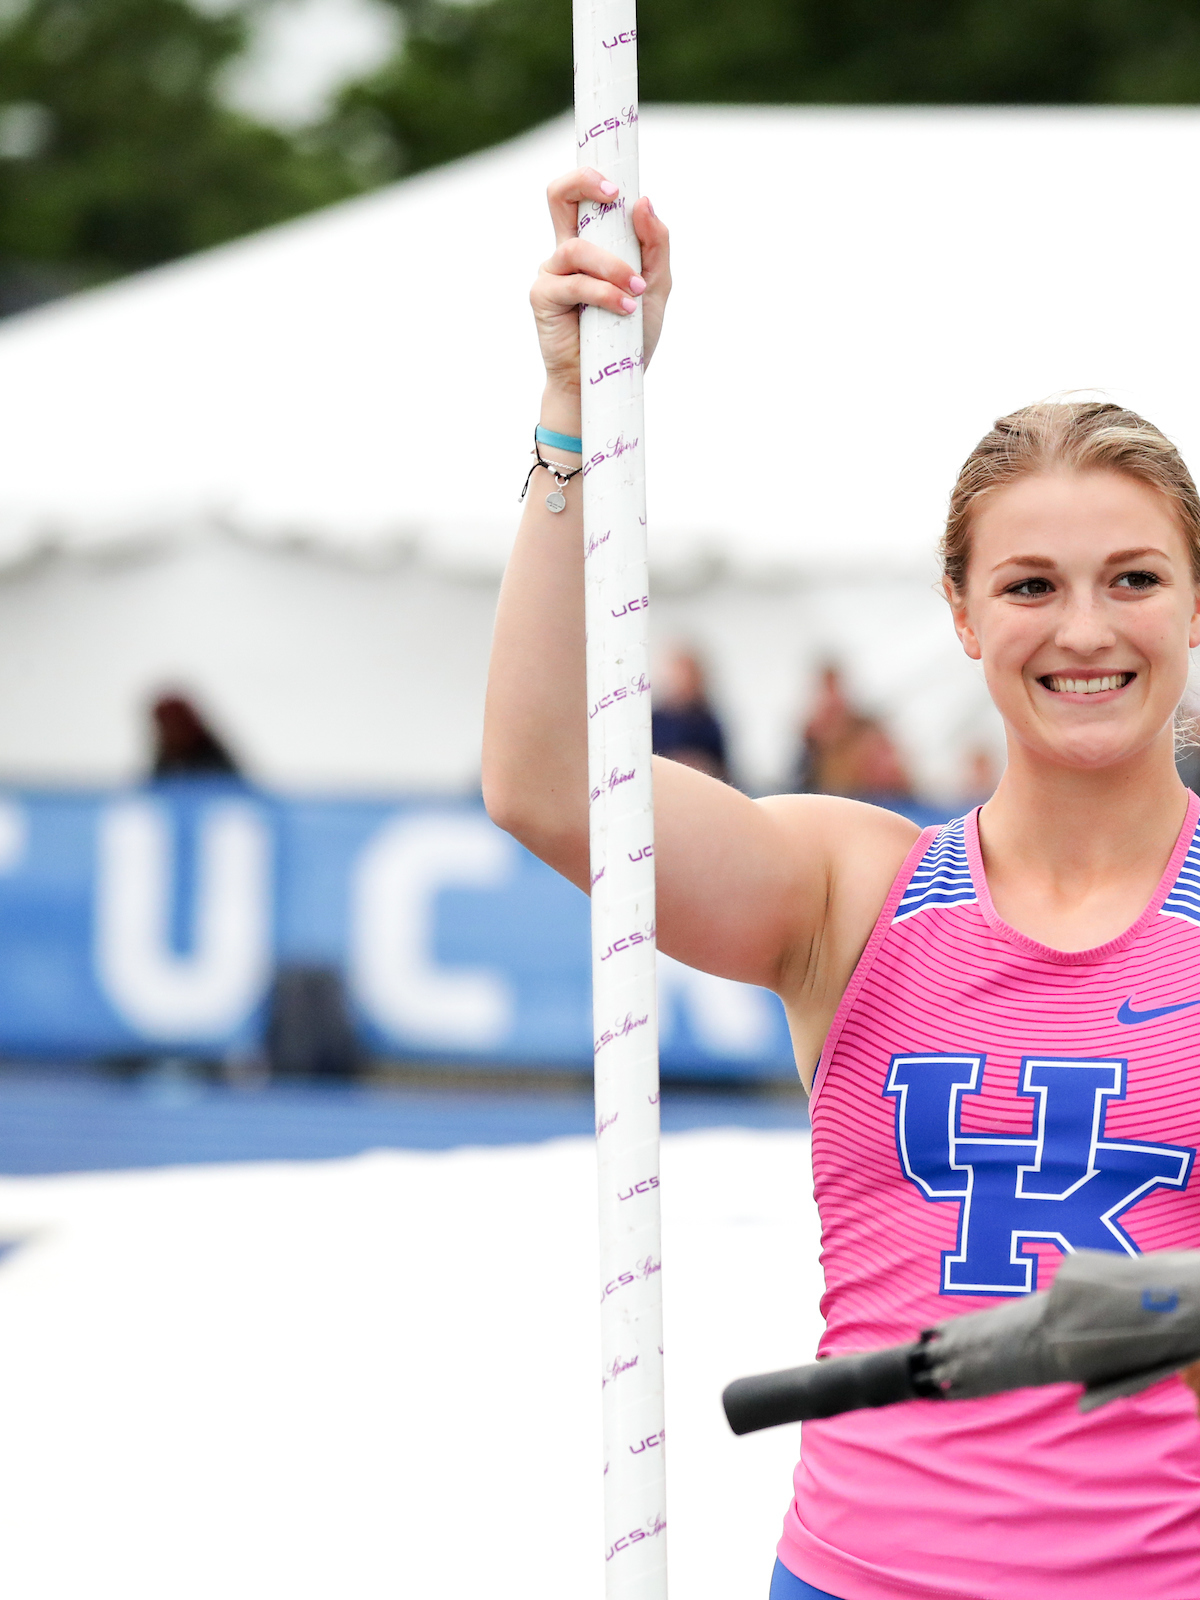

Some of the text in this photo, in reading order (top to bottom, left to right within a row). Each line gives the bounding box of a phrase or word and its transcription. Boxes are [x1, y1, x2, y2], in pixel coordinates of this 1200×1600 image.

[589, 356, 634, 385] UCS
[583, 451, 605, 477] CS
[600, 931, 645, 961] UCS
[614, 1010, 649, 1037] Spirit
[617, 1175, 660, 1201] UCS
[882, 1052, 1197, 1297] UK
